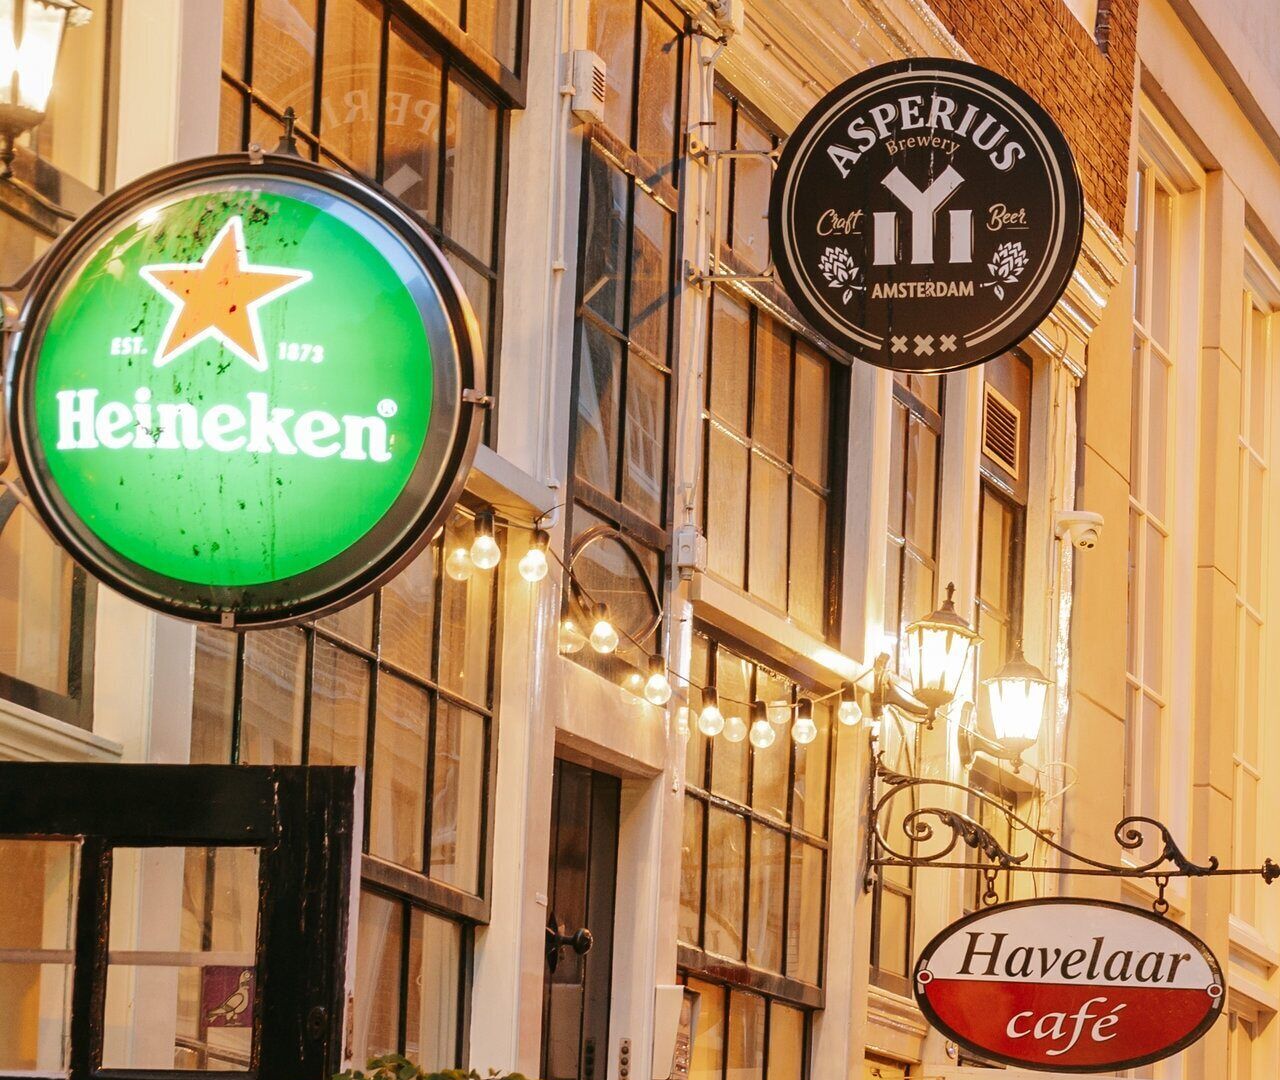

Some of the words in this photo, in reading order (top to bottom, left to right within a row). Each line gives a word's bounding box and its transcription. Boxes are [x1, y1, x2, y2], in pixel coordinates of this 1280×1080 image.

[826, 95, 1026, 179] ASPERIUS
[884, 136, 961, 156] Brewery
[816, 209, 864, 236] Craft
[872, 281, 974, 299] AMSTERDAM
[110, 337, 148, 356] EST.
[278, 342, 325, 364] 1873
[56, 387, 393, 463] Heineken
[956, 931, 1192, 984] Havelaar
[1006, 996, 1128, 1056] café
